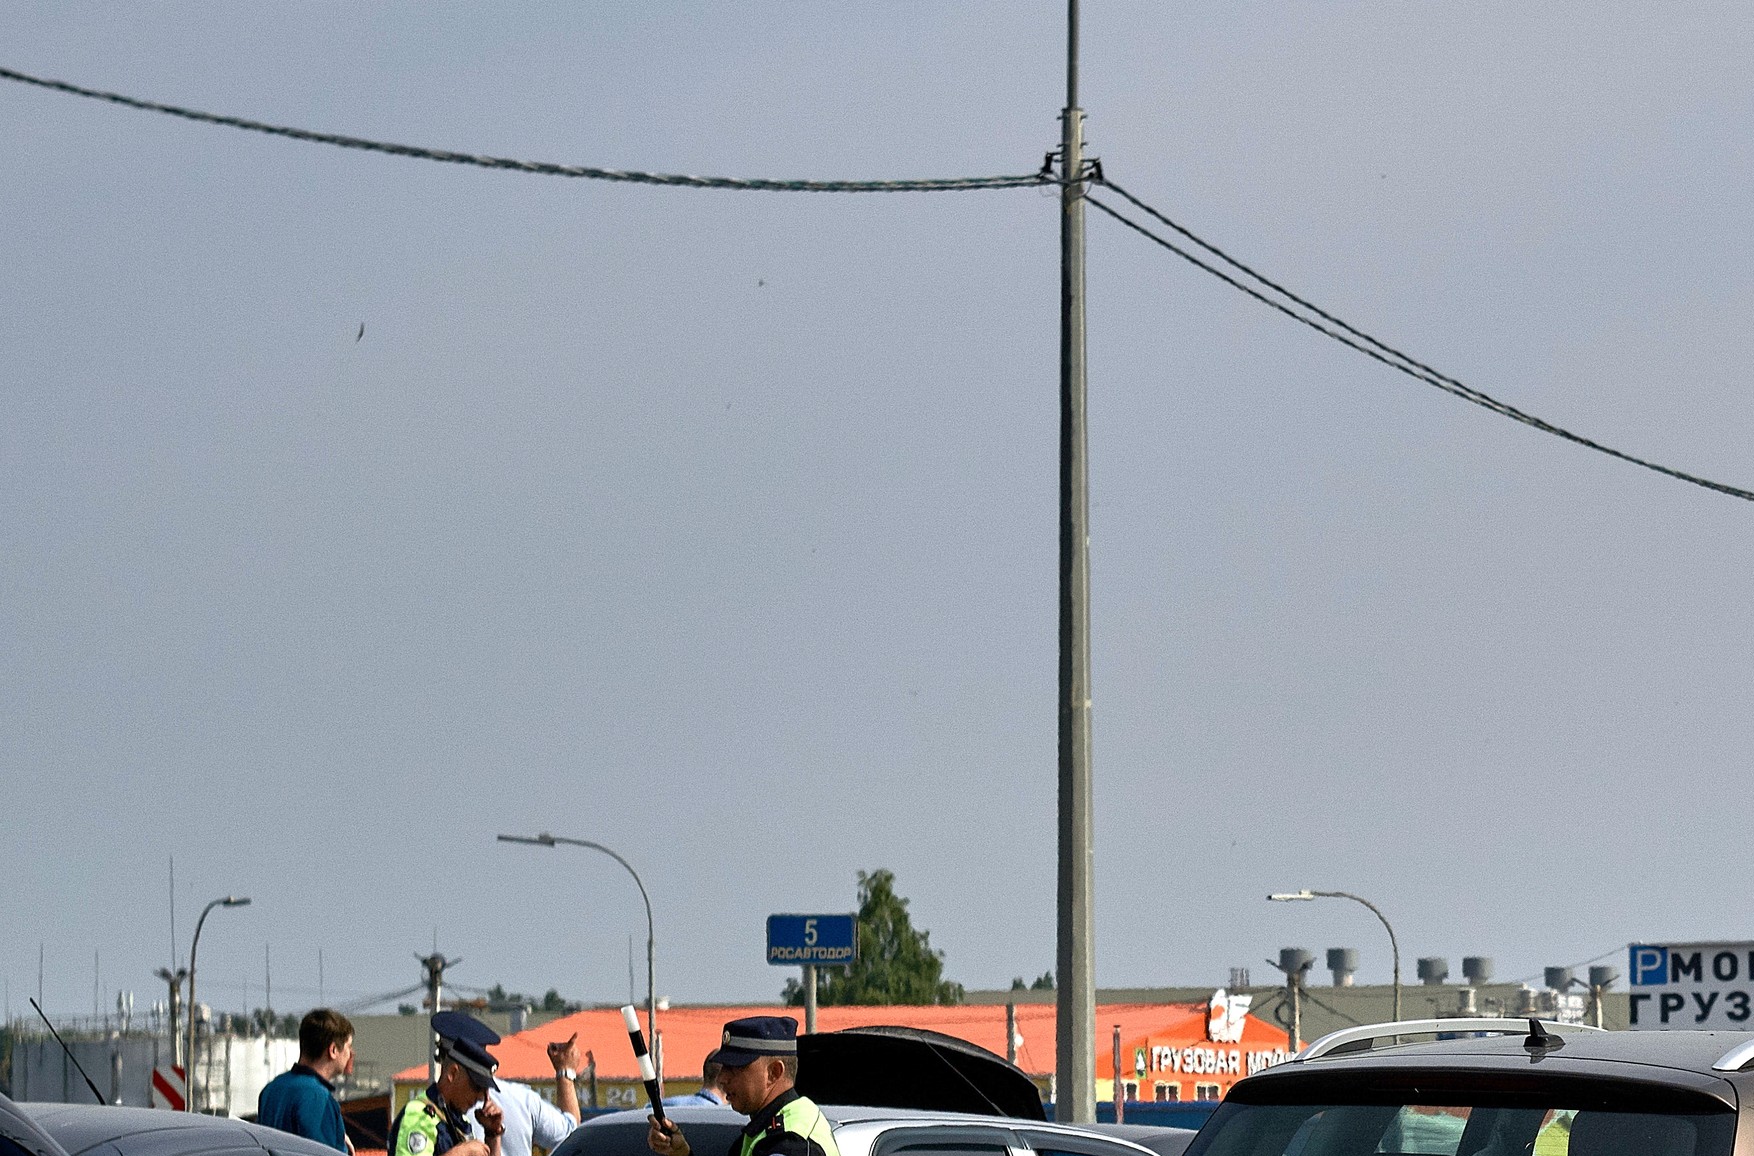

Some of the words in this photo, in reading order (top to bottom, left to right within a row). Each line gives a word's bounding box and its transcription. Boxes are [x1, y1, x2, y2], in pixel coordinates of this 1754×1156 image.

[805, 919, 818, 946] 5
[770, 946, 852, 960] РОСАВТОДОР
[1150, 1046, 1240, 1076] ГРУЗОВАЯ
